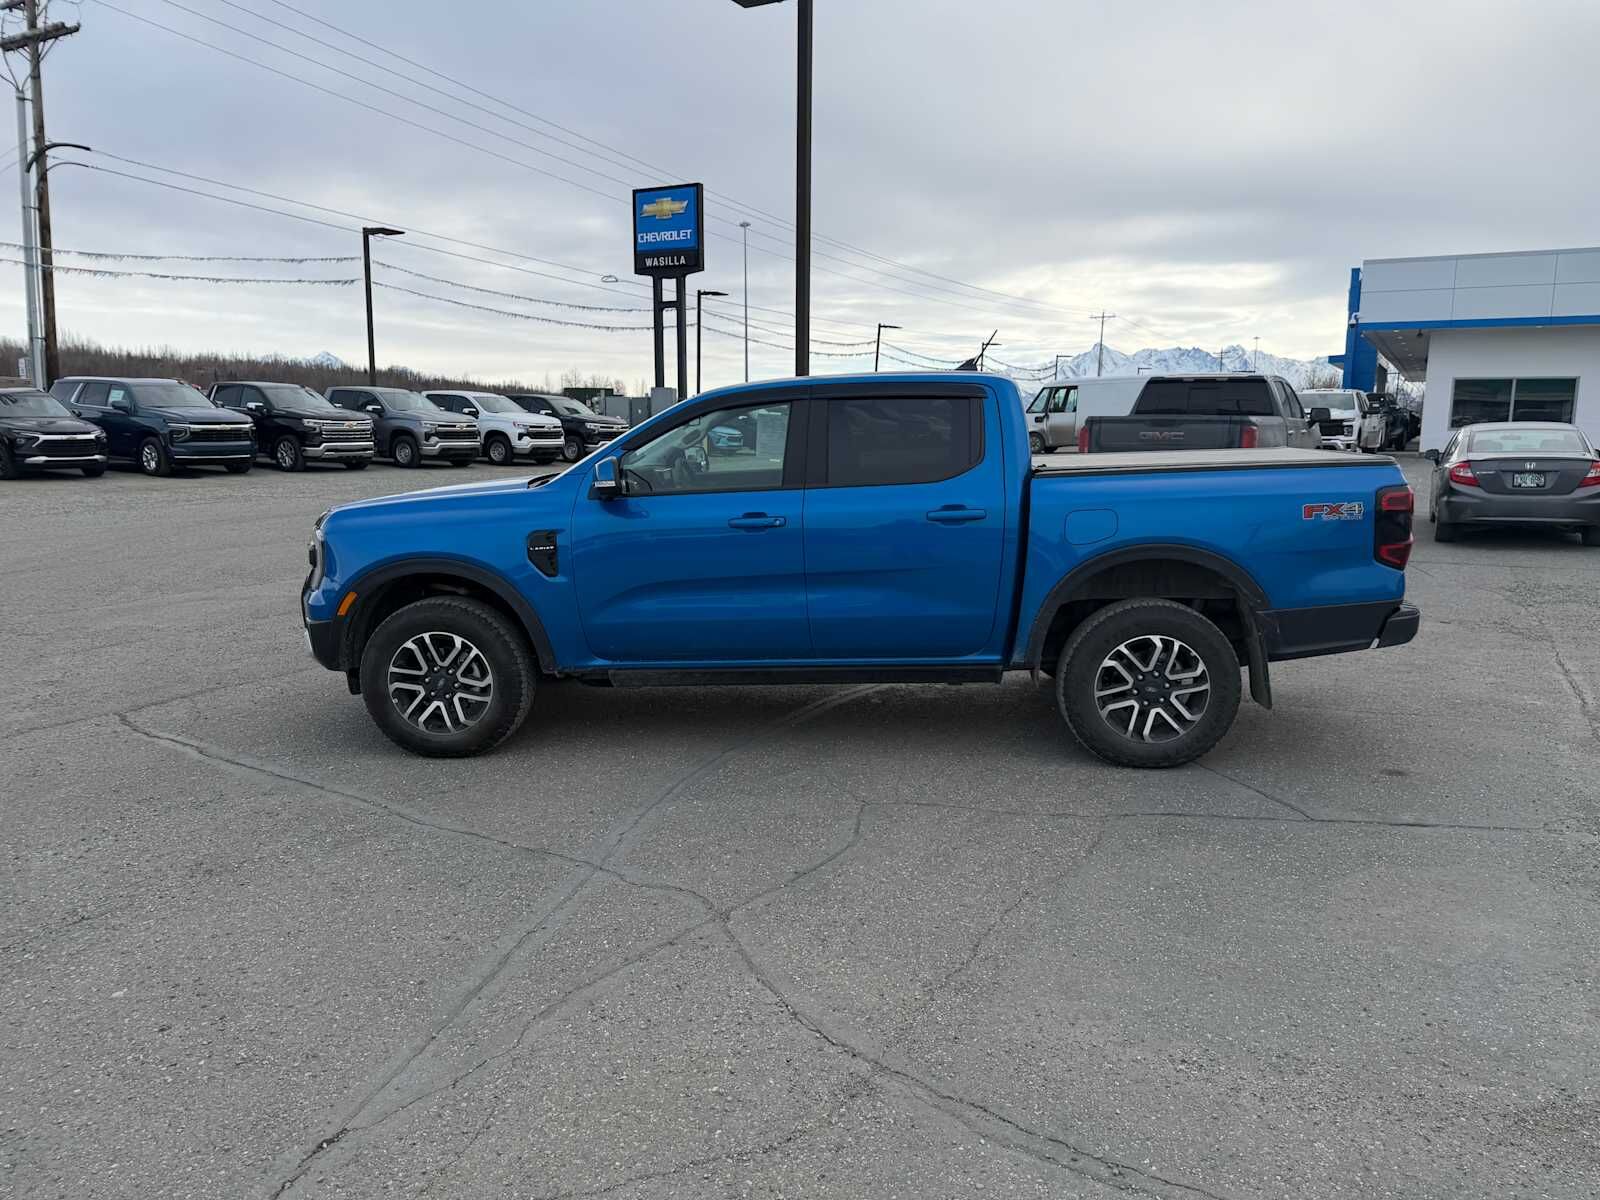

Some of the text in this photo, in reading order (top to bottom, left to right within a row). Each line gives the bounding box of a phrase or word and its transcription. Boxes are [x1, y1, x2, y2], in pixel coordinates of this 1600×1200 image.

[638, 229, 692, 243] CHEVROLET
[645, 256, 686, 267] WASILLA
[1139, 431, 1184, 440] GMC
[1303, 502, 1364, 519] FX4
